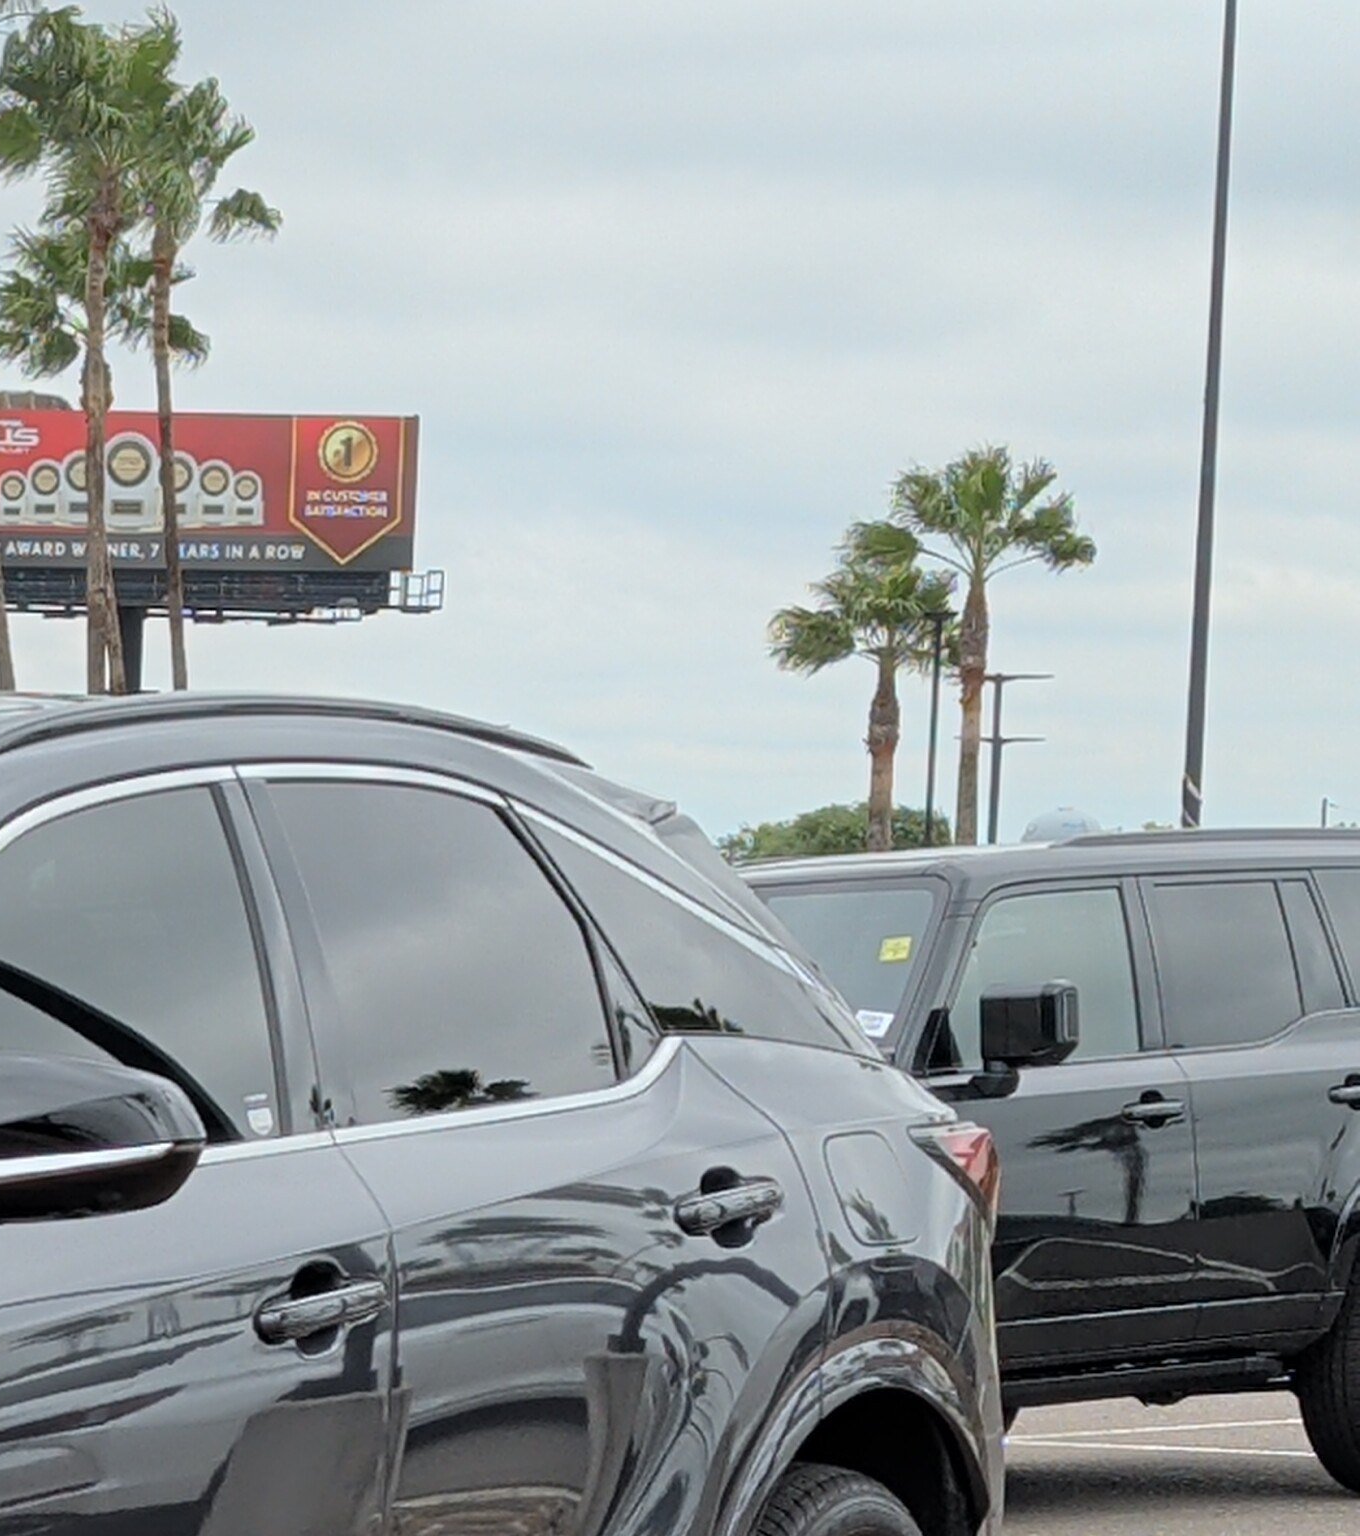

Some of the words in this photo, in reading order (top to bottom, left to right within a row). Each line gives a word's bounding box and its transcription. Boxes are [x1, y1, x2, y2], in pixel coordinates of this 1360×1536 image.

[5, 542, 66, 557] AWARD
[72, 543, 146, 560] WNER,
[150, 543, 160, 558] 7
[178, 543, 220, 560] EARS
[225, 545, 243, 559] IN
[248, 545, 261, 559] A
[265, 545, 306, 559] ROW
